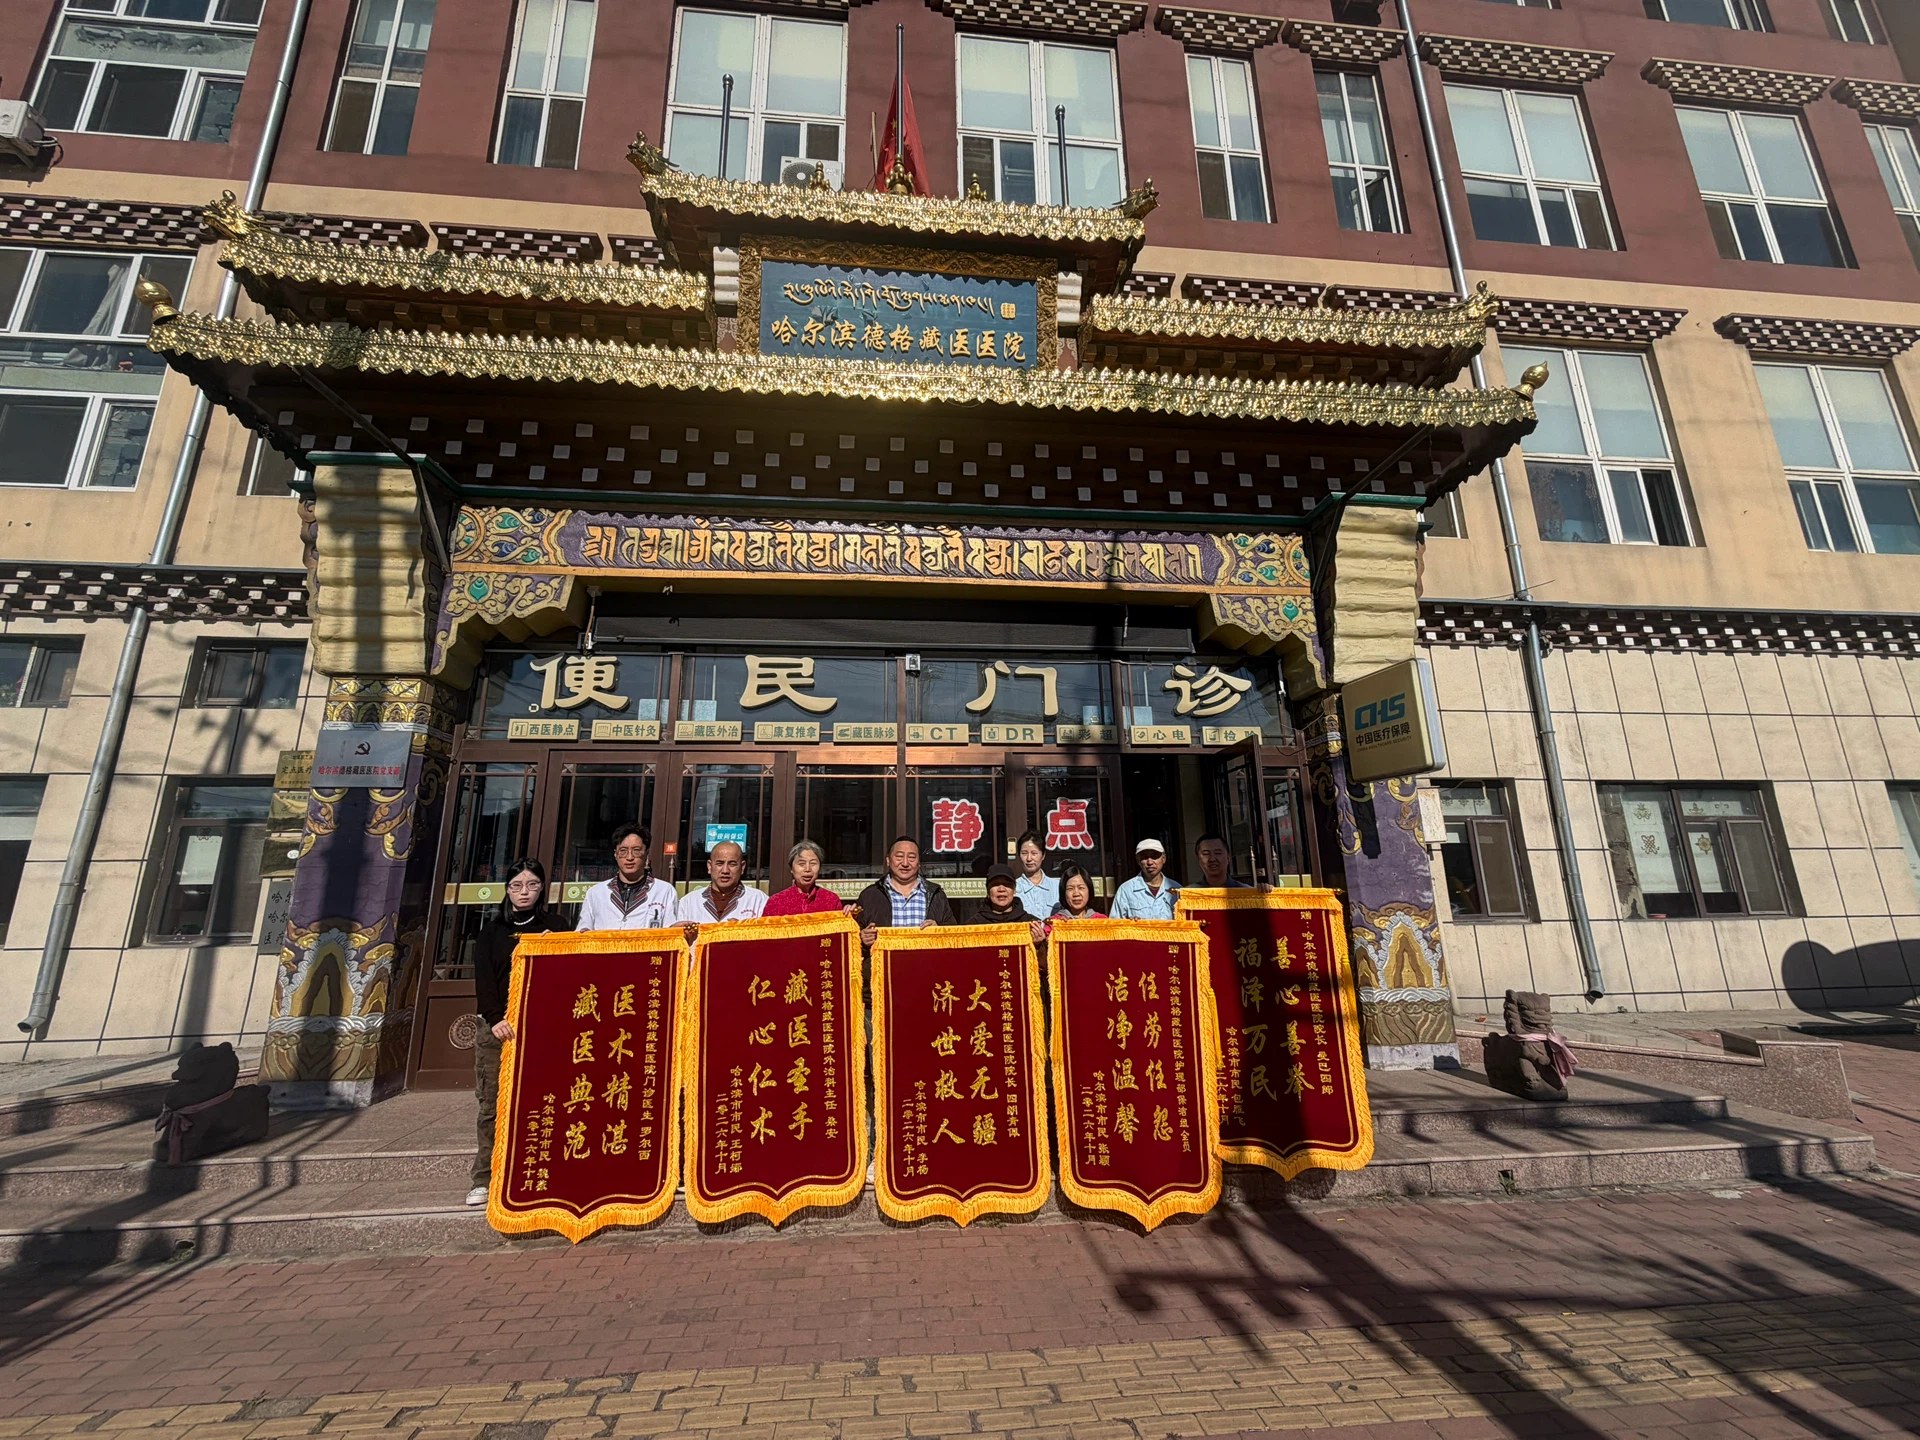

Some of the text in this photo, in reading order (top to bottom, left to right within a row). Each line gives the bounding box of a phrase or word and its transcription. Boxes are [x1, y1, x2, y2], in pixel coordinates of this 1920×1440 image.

[771, 315, 1026, 361] 哈尔滨德格藏医医院
[530, 655, 1252, 717] 便民门诊
[1355, 692, 1405, 731] CHS
[529, 722, 575, 737] 西医静点
[611, 724, 657, 737] 中医针灸
[694, 725, 739, 738] 藏医外治
[772, 725, 817, 738] 康复推拿
[852, 726, 895, 739] 藏医脉诊
[930, 726, 958, 741] CT
[1006, 728, 1035, 741] DR
[1078, 727, 1113, 741] 彩超
[1153, 728, 1186, 741] 心电
[1356, 722, 1411, 747] 中国医疗保障
[1234, 937, 1278, 1101] 福泽万民
[1270, 936, 1314, 1102] 善心善举
[563, 984, 601, 1160] 藏医典范
[602, 984, 636, 1156] 医术精湛
[748, 974, 777, 1144] 仁心仁术
[784, 969, 813, 1141] 藏医圣手
[931, 981, 965, 1144] 济世救人
[967, 979, 998, 1146] 大爱无疆
[1106, 967, 1140, 1144] 洁净温馨
[1138, 971, 1173, 1142] 任劳任怨
[1226, 1026, 1243, 1089] 哈尔滨市市民
[730, 1065, 743, 1134] 哈尔滨市市民
[914, 1080, 928, 1146] 哈尔滨市市民
[1093, 1070, 1108, 1138] 哈尔滨市市民
[1217, 1055, 1229, 1126] 二六年十月
[520, 1111, 540, 1191] 二零二六年十月
[539, 1093, 556, 1161] 哈尔滨市市民
[715, 1093, 728, 1174] 二零二六年十月
[902, 1099, 915, 1177] 二零二六年十月
[1081, 1086, 1096, 1165] 二零二六年十月
